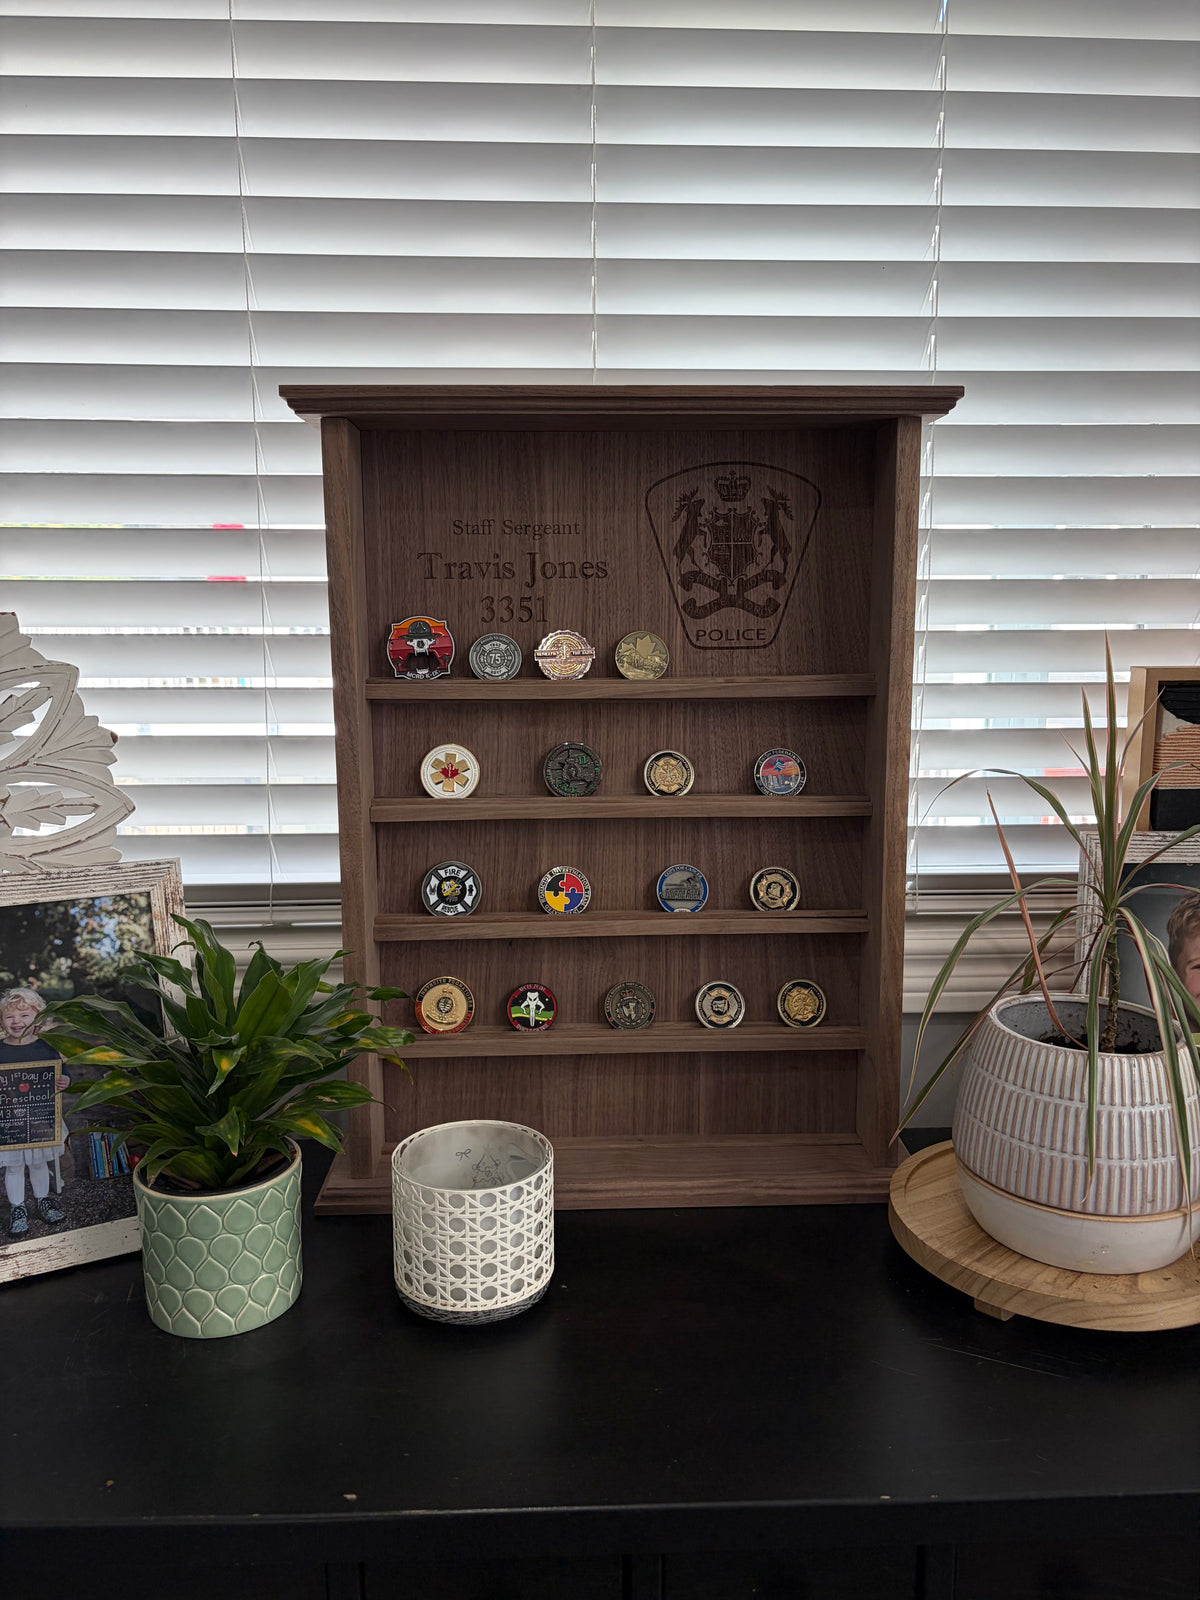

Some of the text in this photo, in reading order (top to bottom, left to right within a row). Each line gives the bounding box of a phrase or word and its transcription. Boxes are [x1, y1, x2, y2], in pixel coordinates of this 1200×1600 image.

[452, 518, 580, 541] Staff Sergeant
[416, 551, 609, 588] Travis Jones
[480, 595, 549, 624] 3351
[696, 629, 767, 642] POLICE
[489, 653, 502, 664] 75
[444, 868, 461, 876] FIRE
[441, 904, 459, 913] RESCUE
[22, 1072, 39, 1083] Day
[42, 1071, 54, 1080] Of
[0, 1089, 50, 1105] Preschool
